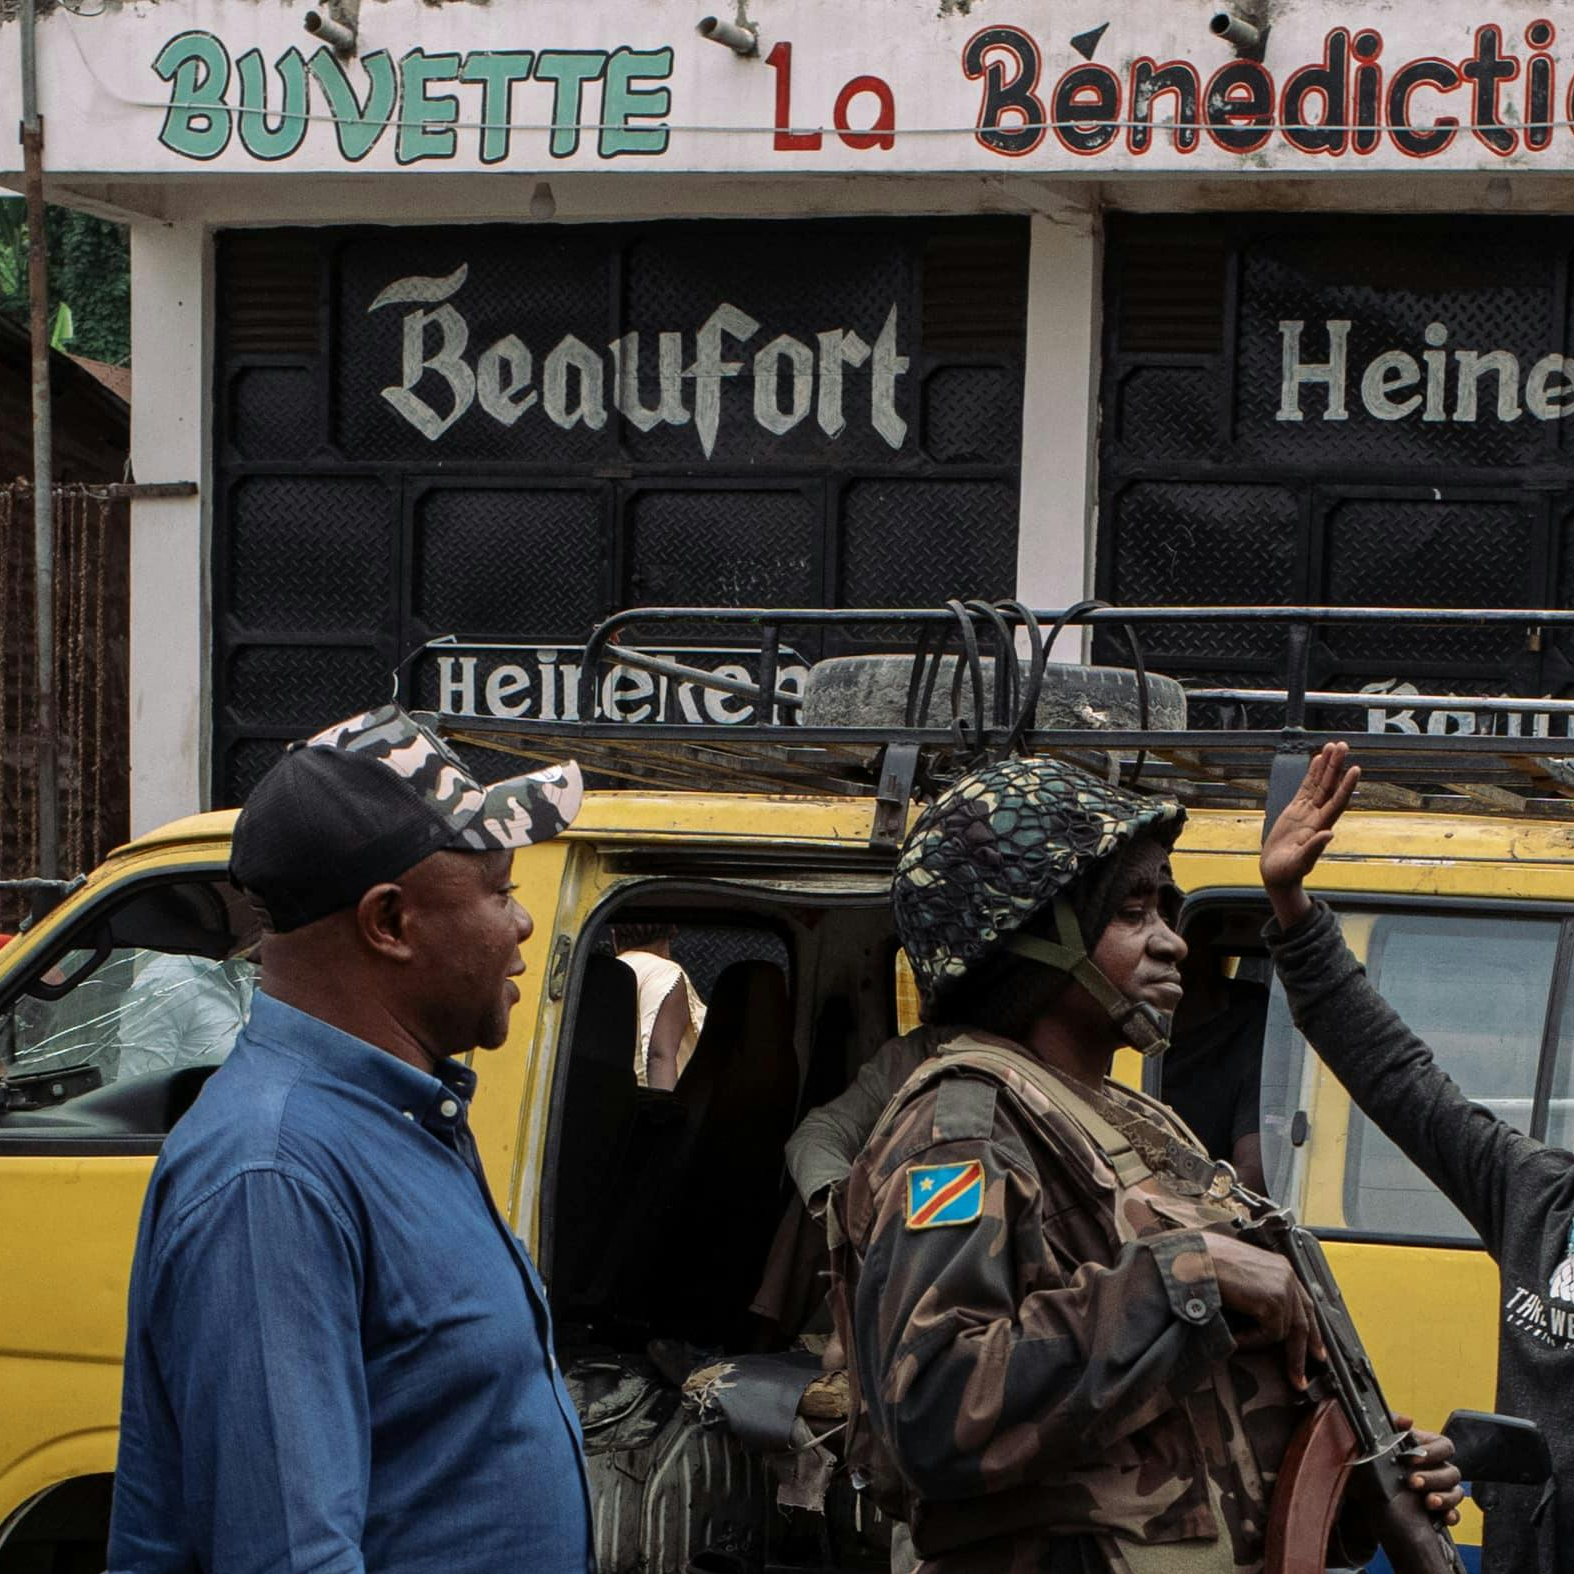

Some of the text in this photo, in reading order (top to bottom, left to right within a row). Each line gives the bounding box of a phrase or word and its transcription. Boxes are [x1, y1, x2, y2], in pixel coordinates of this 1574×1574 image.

[151, 29, 674, 163] BUVETTE
[765, 41, 896, 151] La
[368, 261, 911, 460] Beaufort
